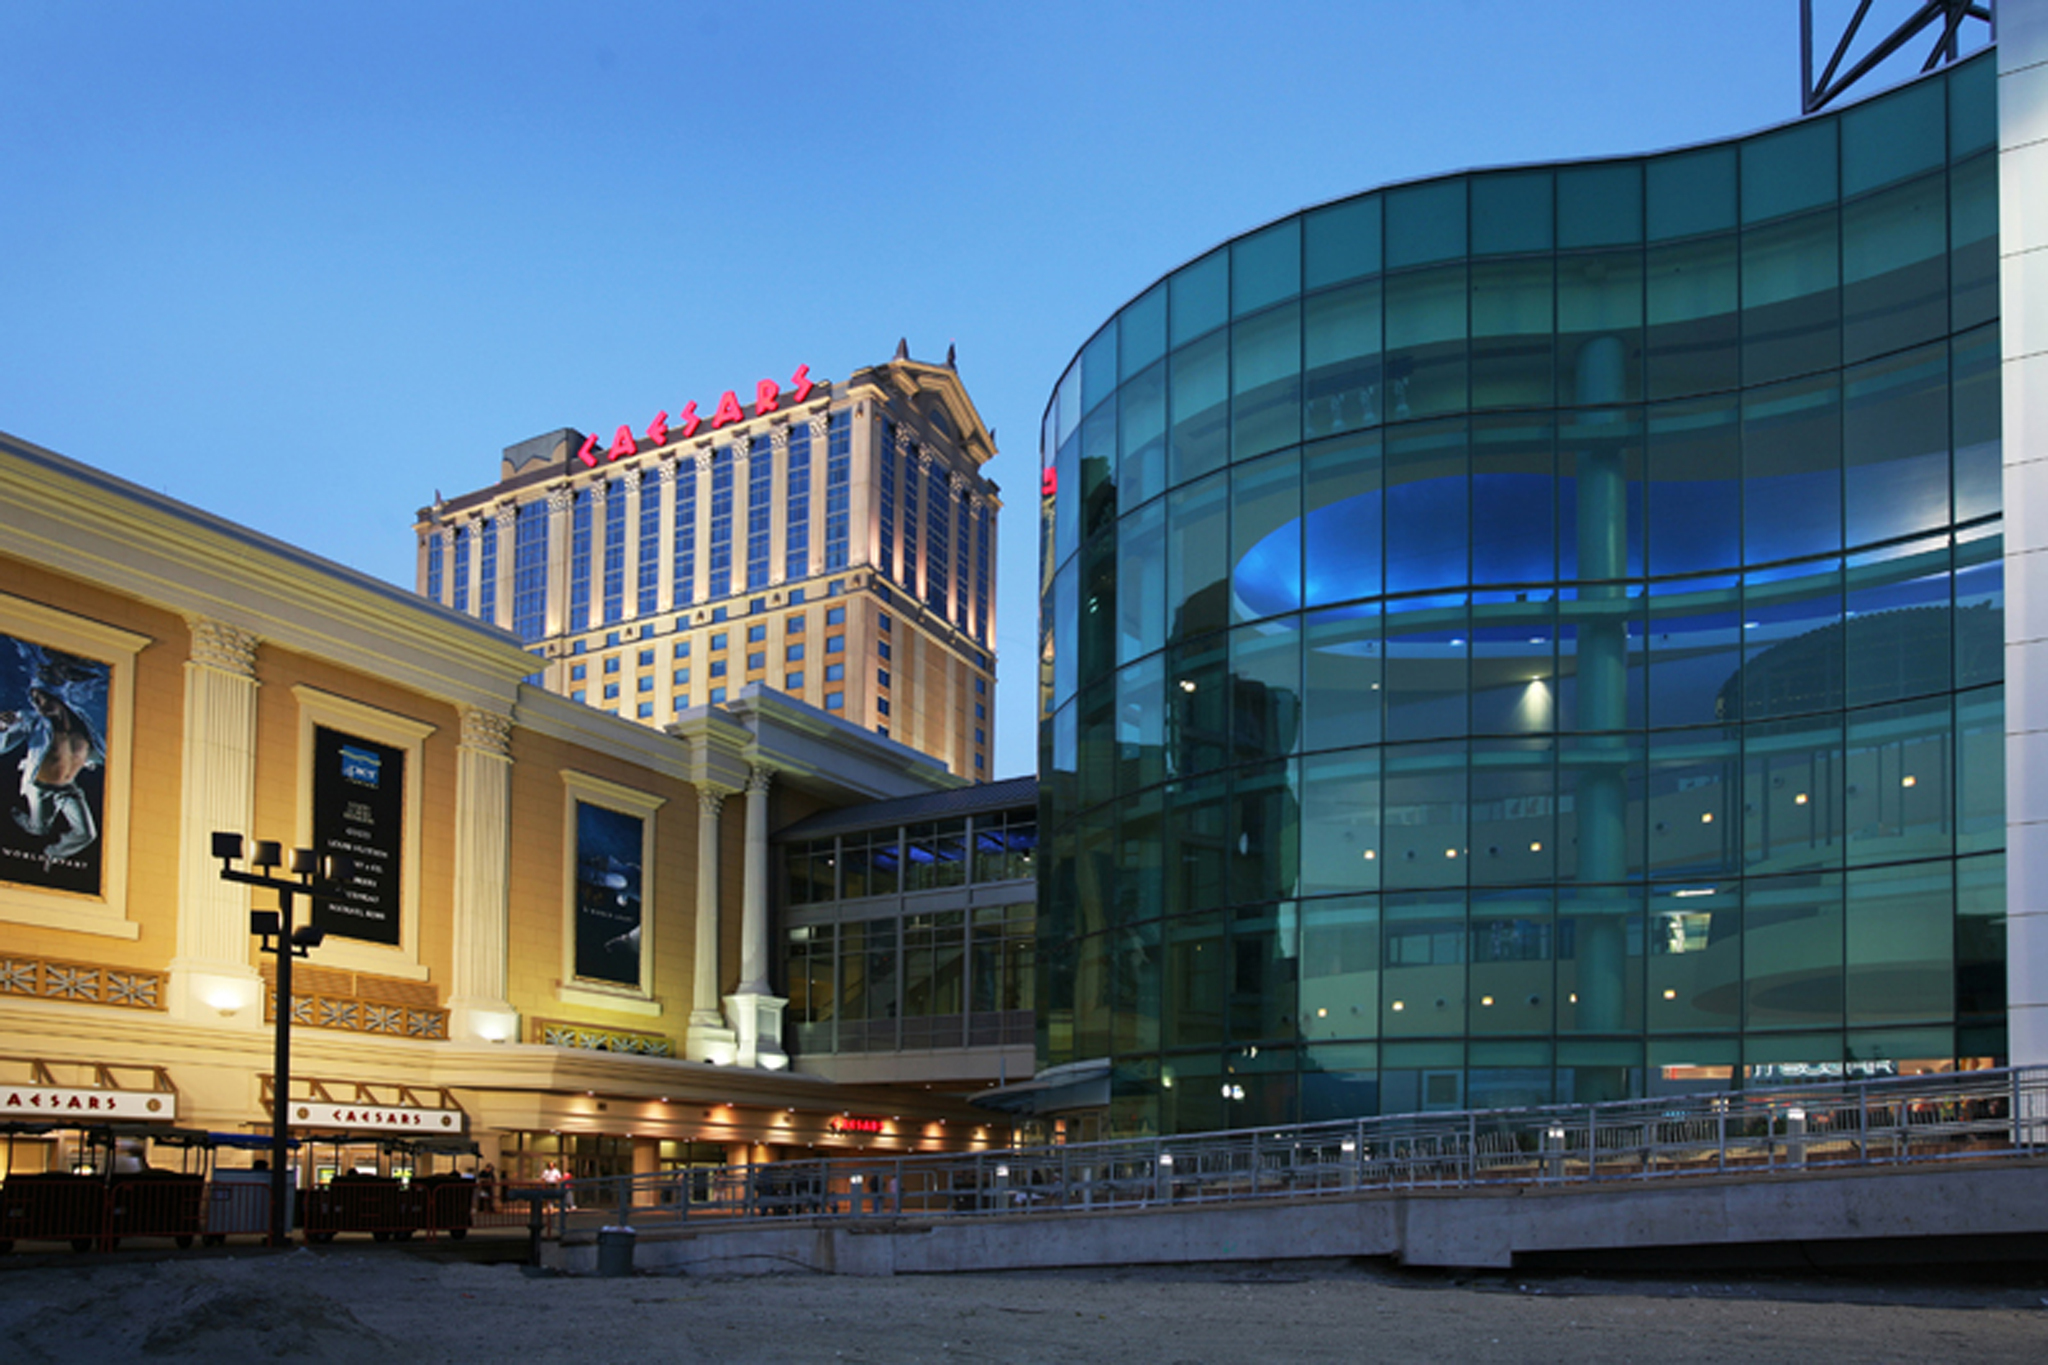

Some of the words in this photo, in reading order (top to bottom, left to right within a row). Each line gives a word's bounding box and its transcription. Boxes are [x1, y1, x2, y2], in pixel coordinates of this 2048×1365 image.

[577, 363, 813, 468] CAESARS
[7, 1092, 117, 1110] AESARS
[332, 1109, 421, 1125] CAESARS
